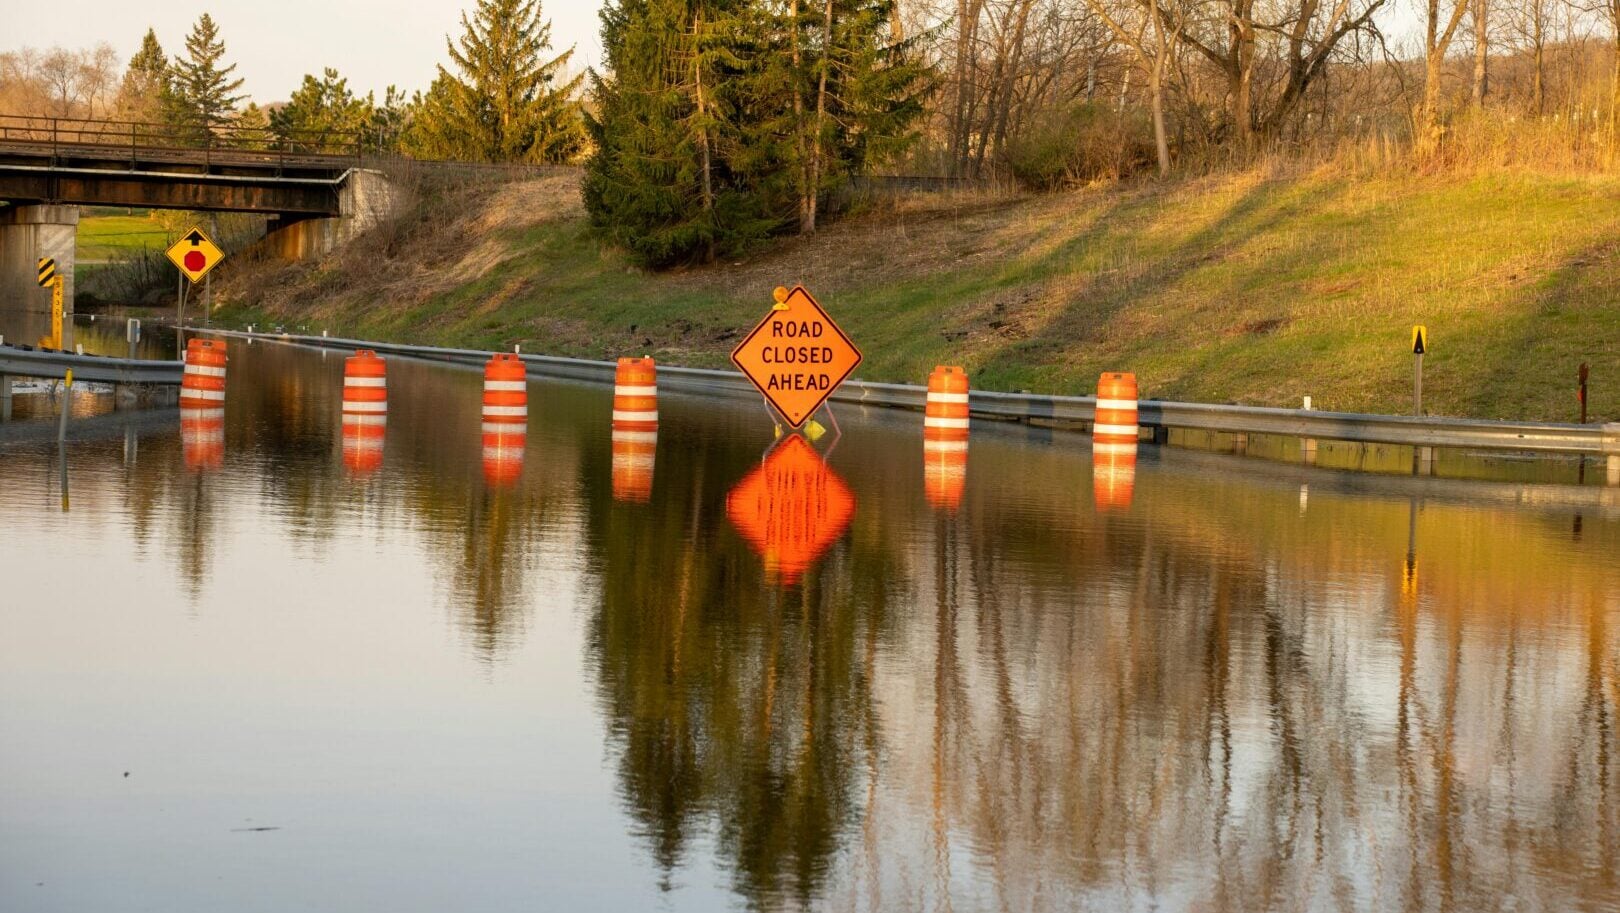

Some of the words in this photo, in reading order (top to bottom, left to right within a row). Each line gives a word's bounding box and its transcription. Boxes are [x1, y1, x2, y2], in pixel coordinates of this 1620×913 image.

[772, 321, 823, 338] ROAD
[762, 346, 833, 364] CLOSED
[767, 373, 830, 390] AHEAD
